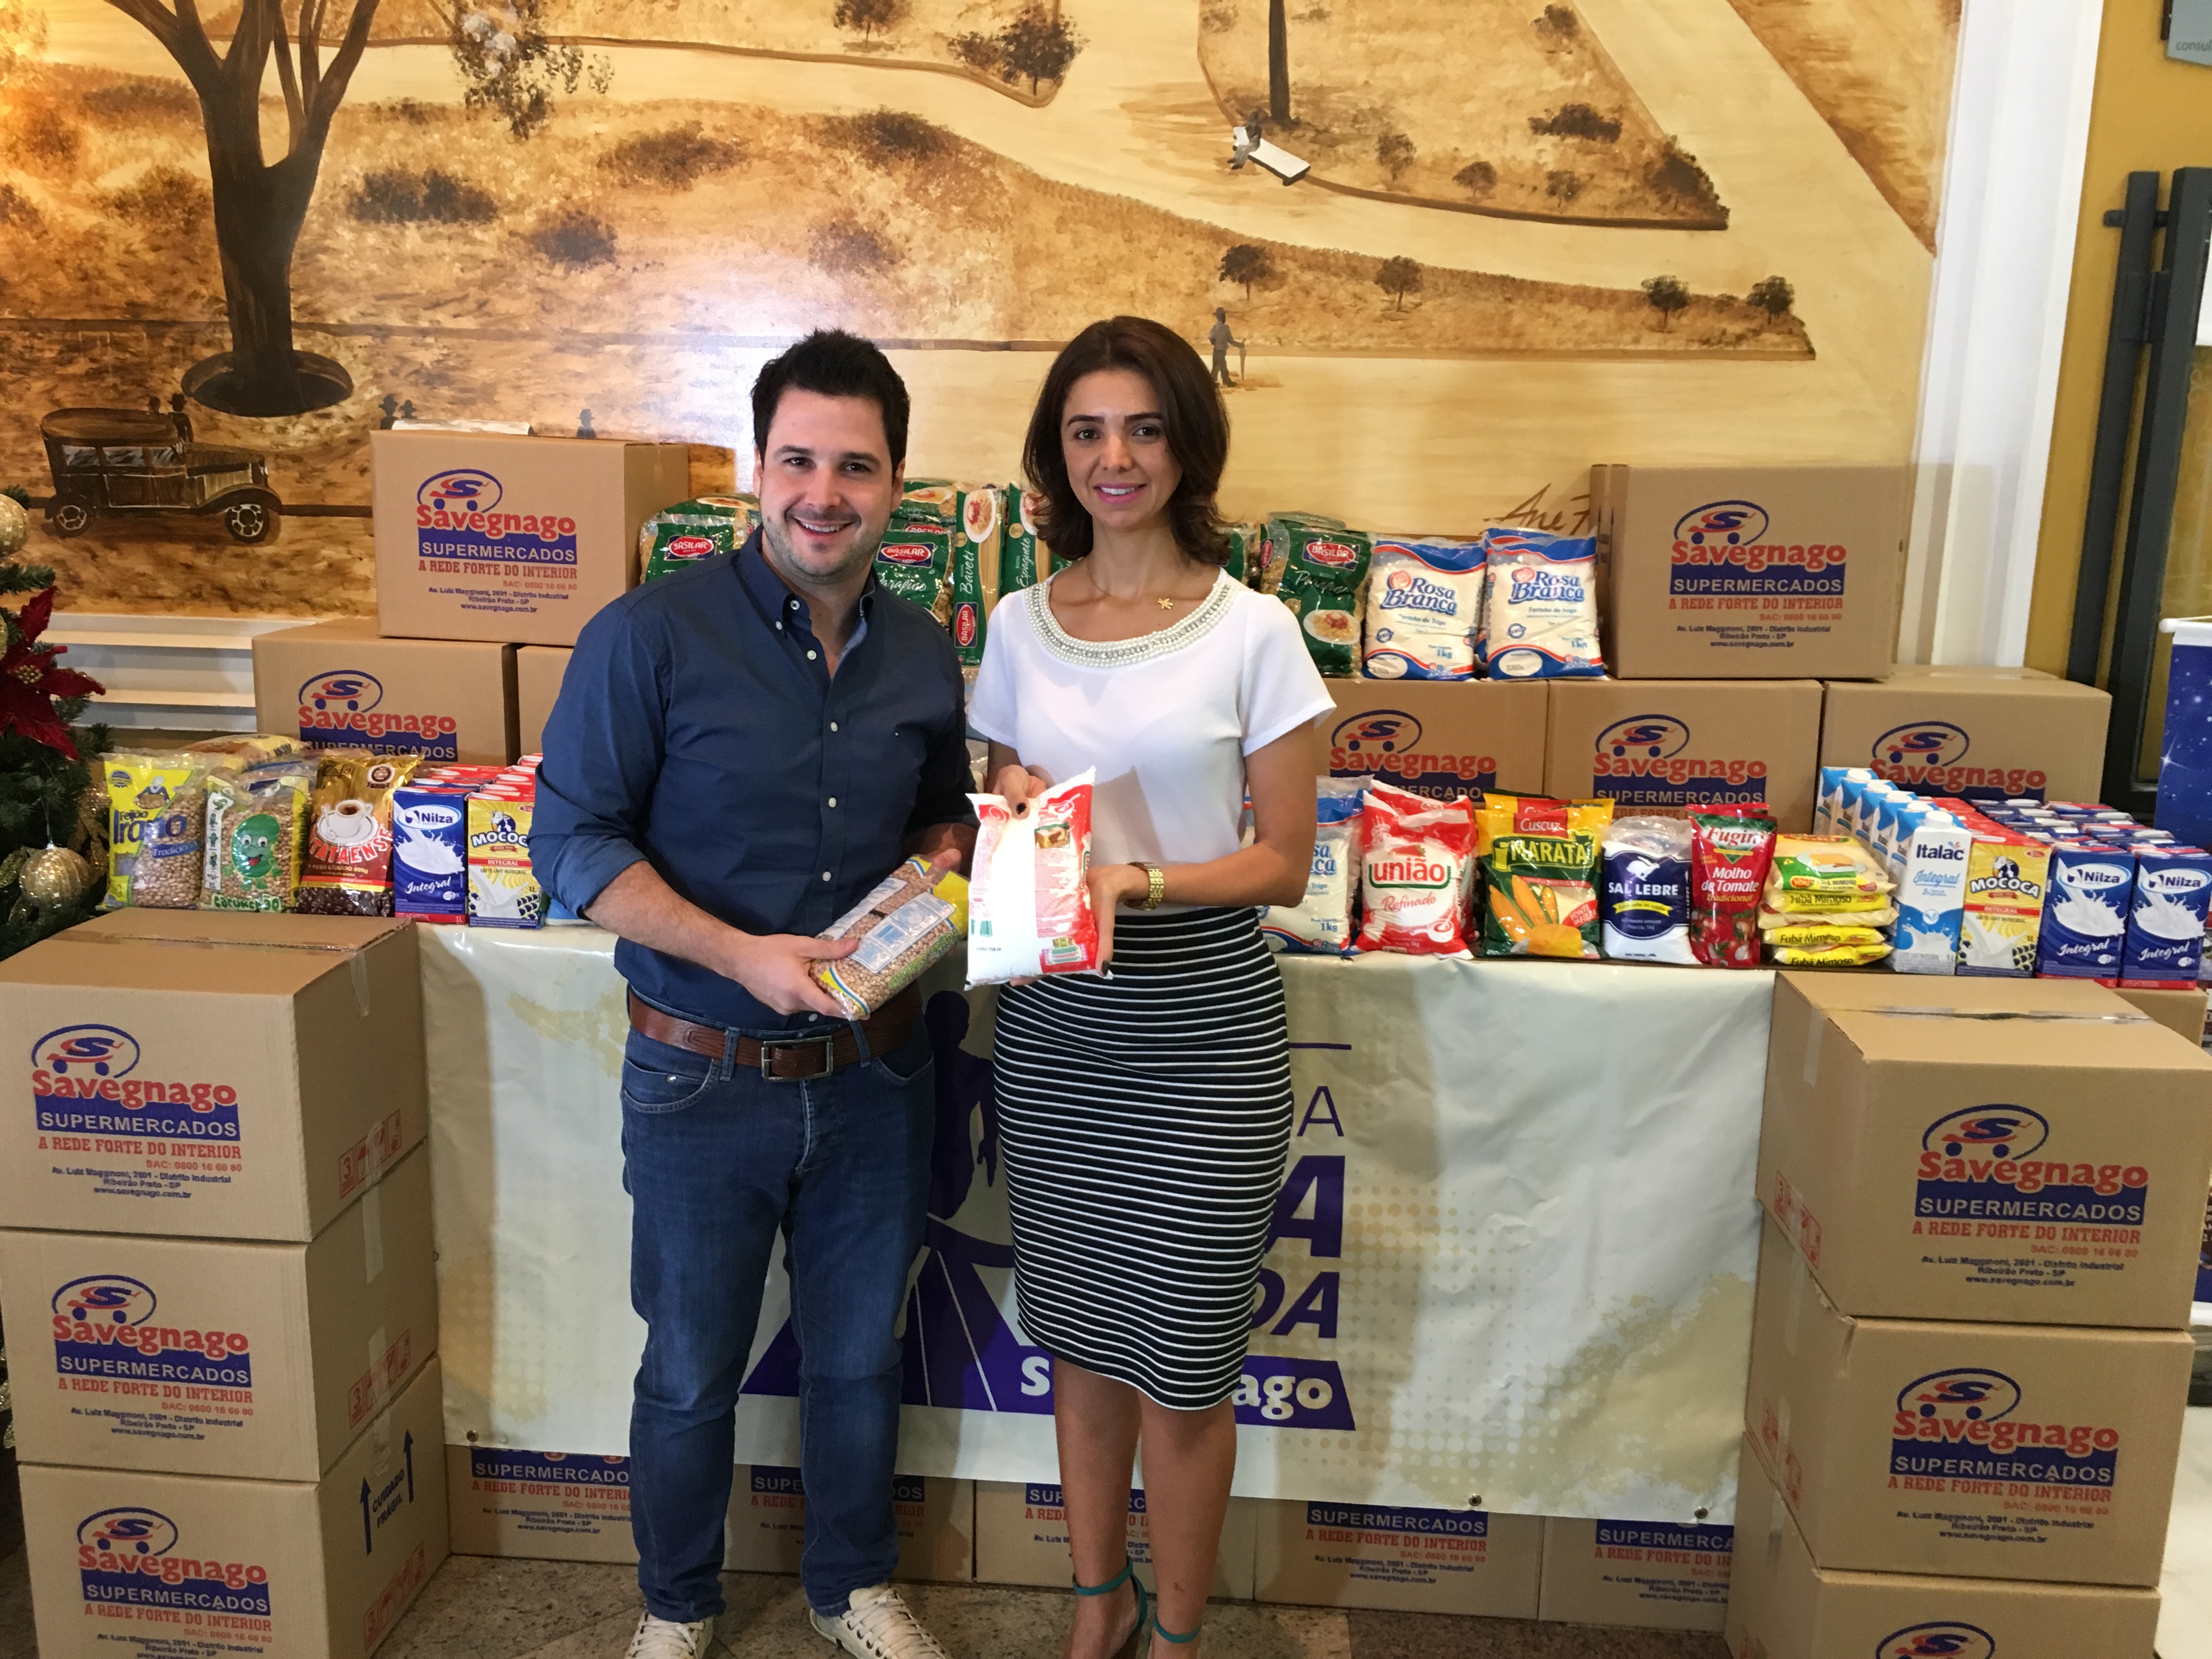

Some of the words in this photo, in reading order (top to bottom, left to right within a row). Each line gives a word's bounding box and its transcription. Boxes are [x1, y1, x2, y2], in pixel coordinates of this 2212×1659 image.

[417, 504, 576, 539] Savegnago
[421, 541, 575, 563] SUPERMERCADOS
[887, 548, 925, 557] BASILAR
[1016, 537, 1032, 587] Espaguete
[1312, 546, 1349, 558] BASILAR
[1672, 540, 1847, 570] Savegnago
[418, 559, 427, 571] A
[429, 560, 461, 573] REDE
[463, 562, 501, 575] FORTE
[504, 564, 520, 576] DO
[522, 565, 578, 579] INTERIOR
[960, 550, 974, 595] Baveti
[1536, 571, 1579, 586] Rosa
[503, 579, 523, 587] SAC:
[524, 580, 544, 588] 0800
[1410, 577, 1455, 600] Rosa
[1509, 583, 1584, 604] Branca
[1674, 579, 1842, 592] SUPERMERCADOS
[1380, 589, 1457, 616] Branca
[1668, 597, 1677, 610] A
[1680, 597, 1714, 610] REDE
[1717, 597, 1758, 610] FORTE
[1762, 597, 1778, 610] DO
[1783, 597, 1843, 610] INTERIOR
[961, 610, 969, 641] BASILAR
[298, 706, 456, 737] Savegnago
[1330, 747, 1496, 777] Savegnago
[1594, 753, 1767, 783] Savegnago
[1870, 759, 2046, 793] Savegnago
[1596, 789, 1763, 805] SUPERMERCADOS
[421, 812, 454, 824] Nilza
[1520, 819, 1561, 832] Cuscuz
[470, 831, 529, 848] MOCOC
[1916, 844, 1965, 861] Italac
[1374, 857, 1444, 882] união
[1712, 867, 1752, 879] Molho
[1913, 869, 1961, 885] Integral
[2084, 871, 2120, 883] Nilza
[404, 876, 452, 894] Integral
[1609, 882, 1632, 894] SAL
[1635, 884, 1678, 896] LEBRE
[1701, 880, 1715, 891] de
[1717, 880, 1759, 892] Tomate
[1970, 877, 2041, 899] MOCOCA
[2165, 876, 2200, 888] Nilza
[1381, 891, 1436, 912] Refinado
[1814, 894, 1852, 903] Mimoso
[1780, 934, 1803, 944] Fubá
[1804, 933, 1841, 943] Mimoso
[2057, 938, 2111, 956] Integral
[2138, 941, 2190, 961] Integral
[32, 1069, 236, 1111] Savegnago
[40, 1113, 238, 1138] SUPERMERCADOS
[37, 1135, 48, 1148] A
[51, 1135, 92, 1150] REDE
[94, 1137, 143, 1153] FORTE
[146, 1139, 167, 1154] DO
[170, 1141, 242, 1158] INTERIOR
[145, 1158, 172, 1167] SAC:
[1917, 1151, 2148, 1194] Savegnago
[1920, 1198, 2141, 1222] SUPERMERCADOS
[1912, 1220, 1923, 1235] A
[1928, 1221, 1972, 1237] REDE
[1976, 1223, 2030, 1239] FORTE
[2035, 1225, 2057, 1240] DO
[2062, 1226, 2142, 1243] INTERIOR
[53, 1314, 249, 1358] Savegnago
[60, 1356, 250, 1385] SUPERMERCADOS
[57, 1376, 68, 1390] A
[70, 1377, 110, 1393] REDE
[111, 1380, 159, 1397] FORTE
[162, 1384, 182, 1398] DO
[185, 1386, 254, 1404] INTERIOR
[1892, 1410, 2119, 1454] Savegnago
[475, 1463, 629, 1484] SUPERMERCADO
[1894, 1455, 2112, 1483] SUPERMERCADOS
[471, 1481, 481, 1493] A
[483, 1482, 517, 1495] REDE
[520, 1484, 561, 1498] FORTE
[564, 1487, 581, 1499] DO
[584, 1488, 630, 1501] INTERI
[1887, 1477, 1898, 1491] A
[1903, 1478, 1946, 1494] REDE
[1950, 1481, 2003, 1497] FORTE
[2008, 1483, 2029, 1498] DO
[2035, 1485, 2113, 1503] INTERIOR
[1309, 1509, 1485, 1535] SUPERMERCADOS
[1305, 1528, 1314, 1540] A
[1318, 1528, 1353, 1543] REDE
[1356, 1531, 1399, 1546] FORTE
[1403, 1534, 1420, 1547] DO
[1424, 1536, 1486, 1551] INTERIOR
[78, 1544, 267, 1588] Savegnago
[86, 1584, 267, 1613] SUPERMERCADOS
[83, 1603, 94, 1616] A
[96, 1604, 134, 1620] REDE
[136, 1607, 182, 1623] FORTE
[184, 1612, 203, 1625] DO
[206, 1613, 272, 1631] INTERIOR
